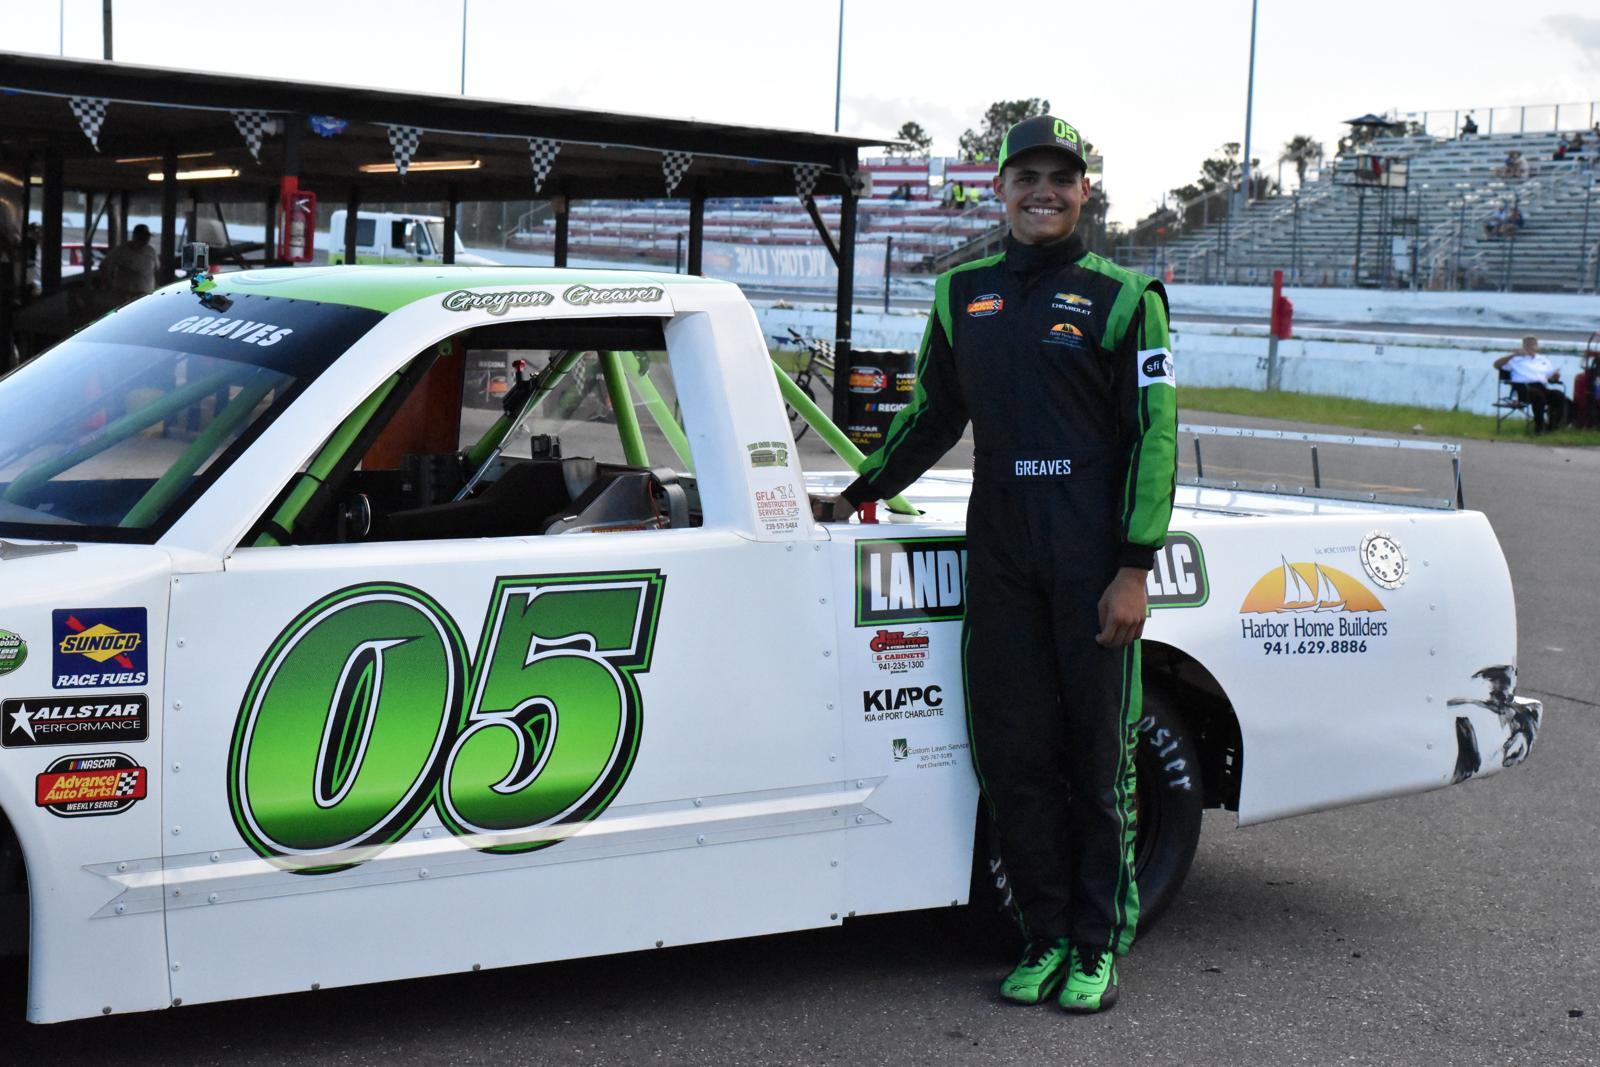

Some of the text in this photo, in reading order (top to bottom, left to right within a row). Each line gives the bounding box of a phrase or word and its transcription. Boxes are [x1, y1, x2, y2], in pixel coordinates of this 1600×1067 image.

[1053, 119, 1078, 144] 05
[442, 284, 665, 316] Greyson Greaves
[1051, 302, 1092, 316] CHEVROLET
[167, 315, 294, 347] GREAVES
[1146, 360, 1160, 373] sfi
[878, 403, 909, 412] REGIO
[1015, 459, 1071, 476] GREAVES
[755, 491, 776, 501] GFLA
[757, 500, 797, 509] CONSTRUCTION
[870, 549, 967, 611] LAND
[1241, 616, 1388, 639] Harbor Home Builders
[63, 634, 139, 652] SUNOCO
[1263, 640, 1367, 655] 941.629.8886
[884, 652, 926, 661] CABINETS
[878, 661, 925, 671] 941-235-1300
[56, 671, 146, 686] RACE FUELS
[32, 703, 140, 720] ALLSTAR
[864, 708, 944, 722] KIA of PORT CHARLOTTE
[34, 720, 141, 734] PERFORMANCE
[227, 569, 667, 875] 05
[931, 745, 948, 753] Lawn
[80, 758, 117, 770] NASCAR
[53, 774, 115, 790] Advance
[44, 786, 112, 801] Auto Parts
[66, 800, 119, 811] WEEKLY SERIES
